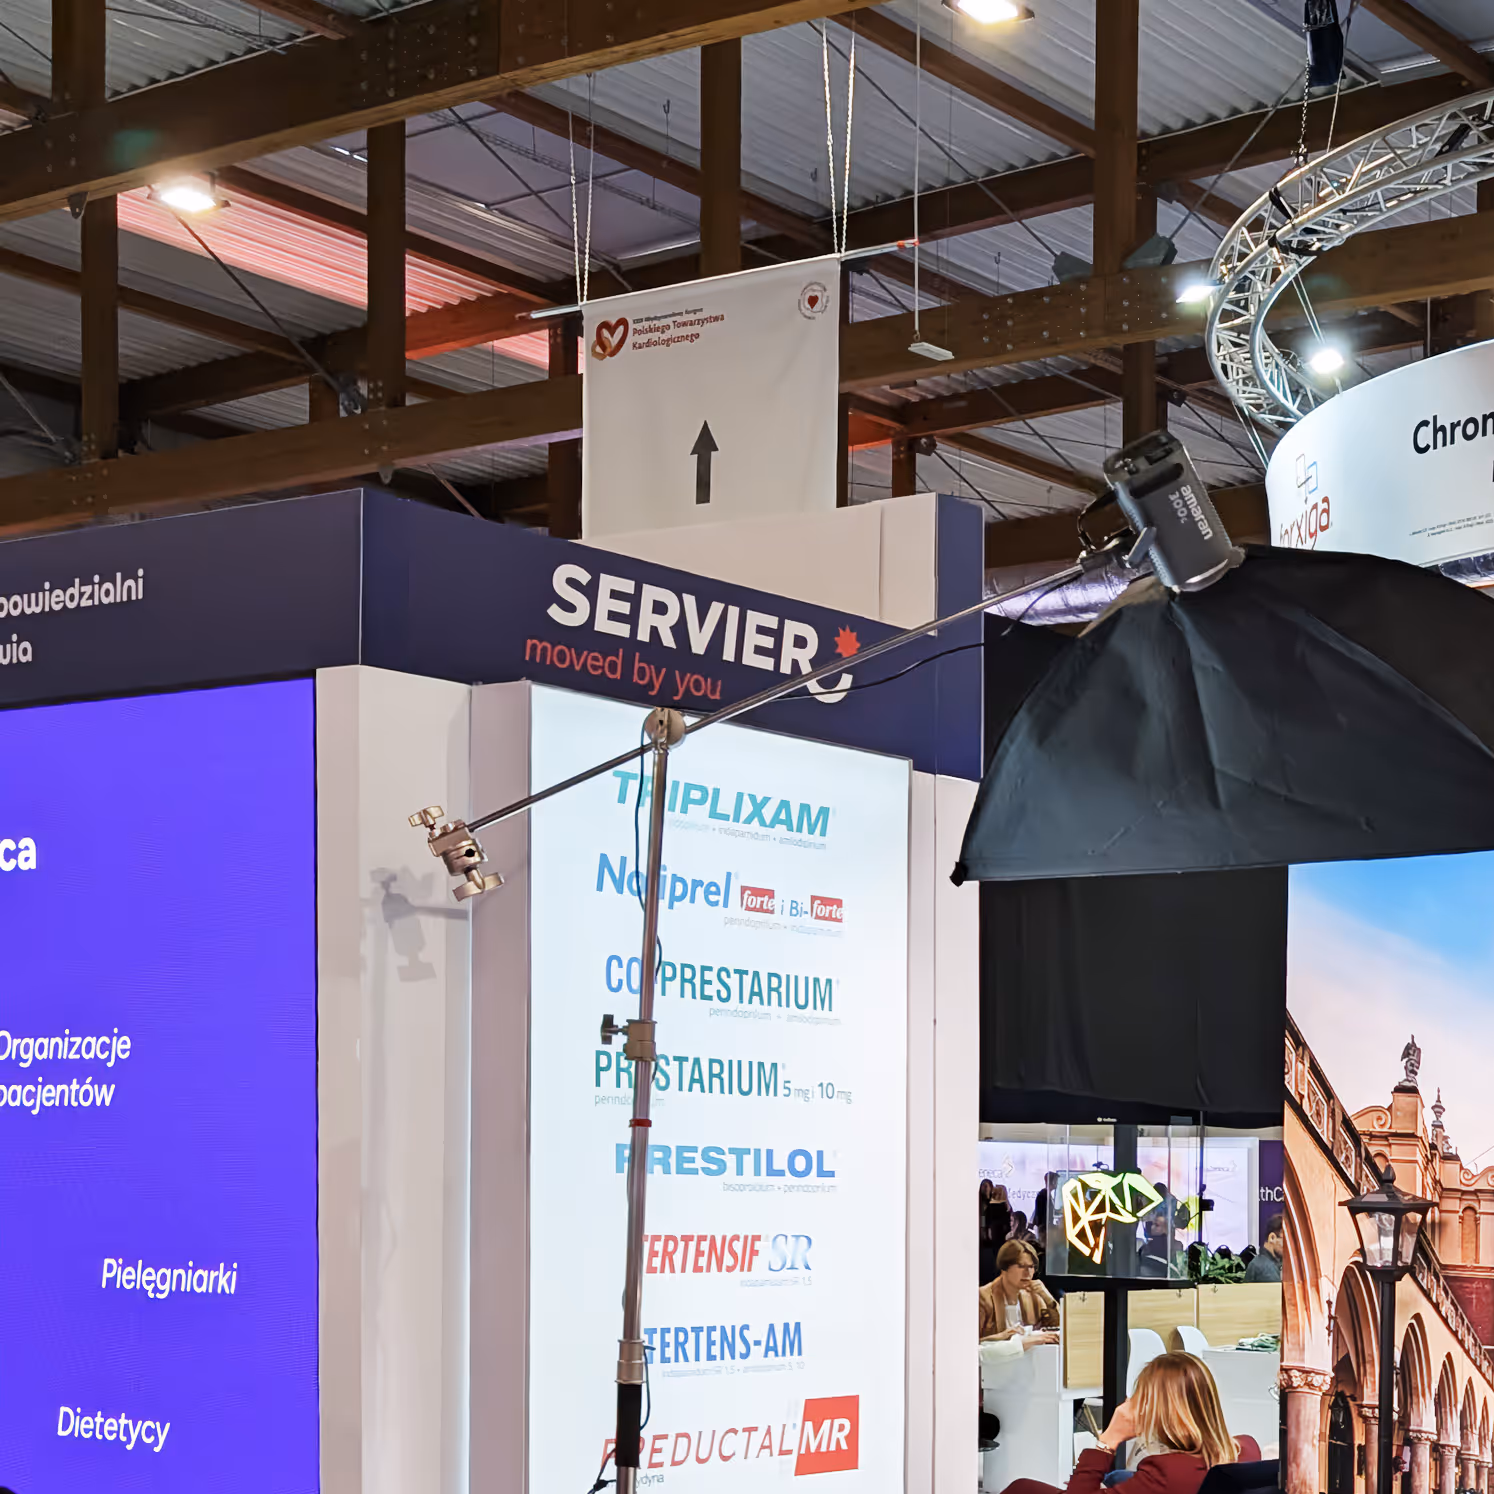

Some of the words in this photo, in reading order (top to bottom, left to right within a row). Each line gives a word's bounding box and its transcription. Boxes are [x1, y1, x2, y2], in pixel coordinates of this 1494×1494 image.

[1180, 484, 1214, 540] amaran
[546, 563, 853, 703] SERVIER
[524, 634, 623, 681] moved
[632, 648, 668, 695] by
[672, 662, 722, 702] you
[596, 852, 733, 910] Noiprel
[742, 889, 775, 913] forte
[594, 1049, 779, 1098] PRSTARIUM
[782, 1080, 792, 1098] 5
[817, 1082, 835, 1100] 10
[768, 1233, 813, 1272] SR
[101, 1257, 238, 1300] Pielęgniarki
[57, 1405, 171, 1452] Dietetycy
[799, 1417, 852, 1455] MR
